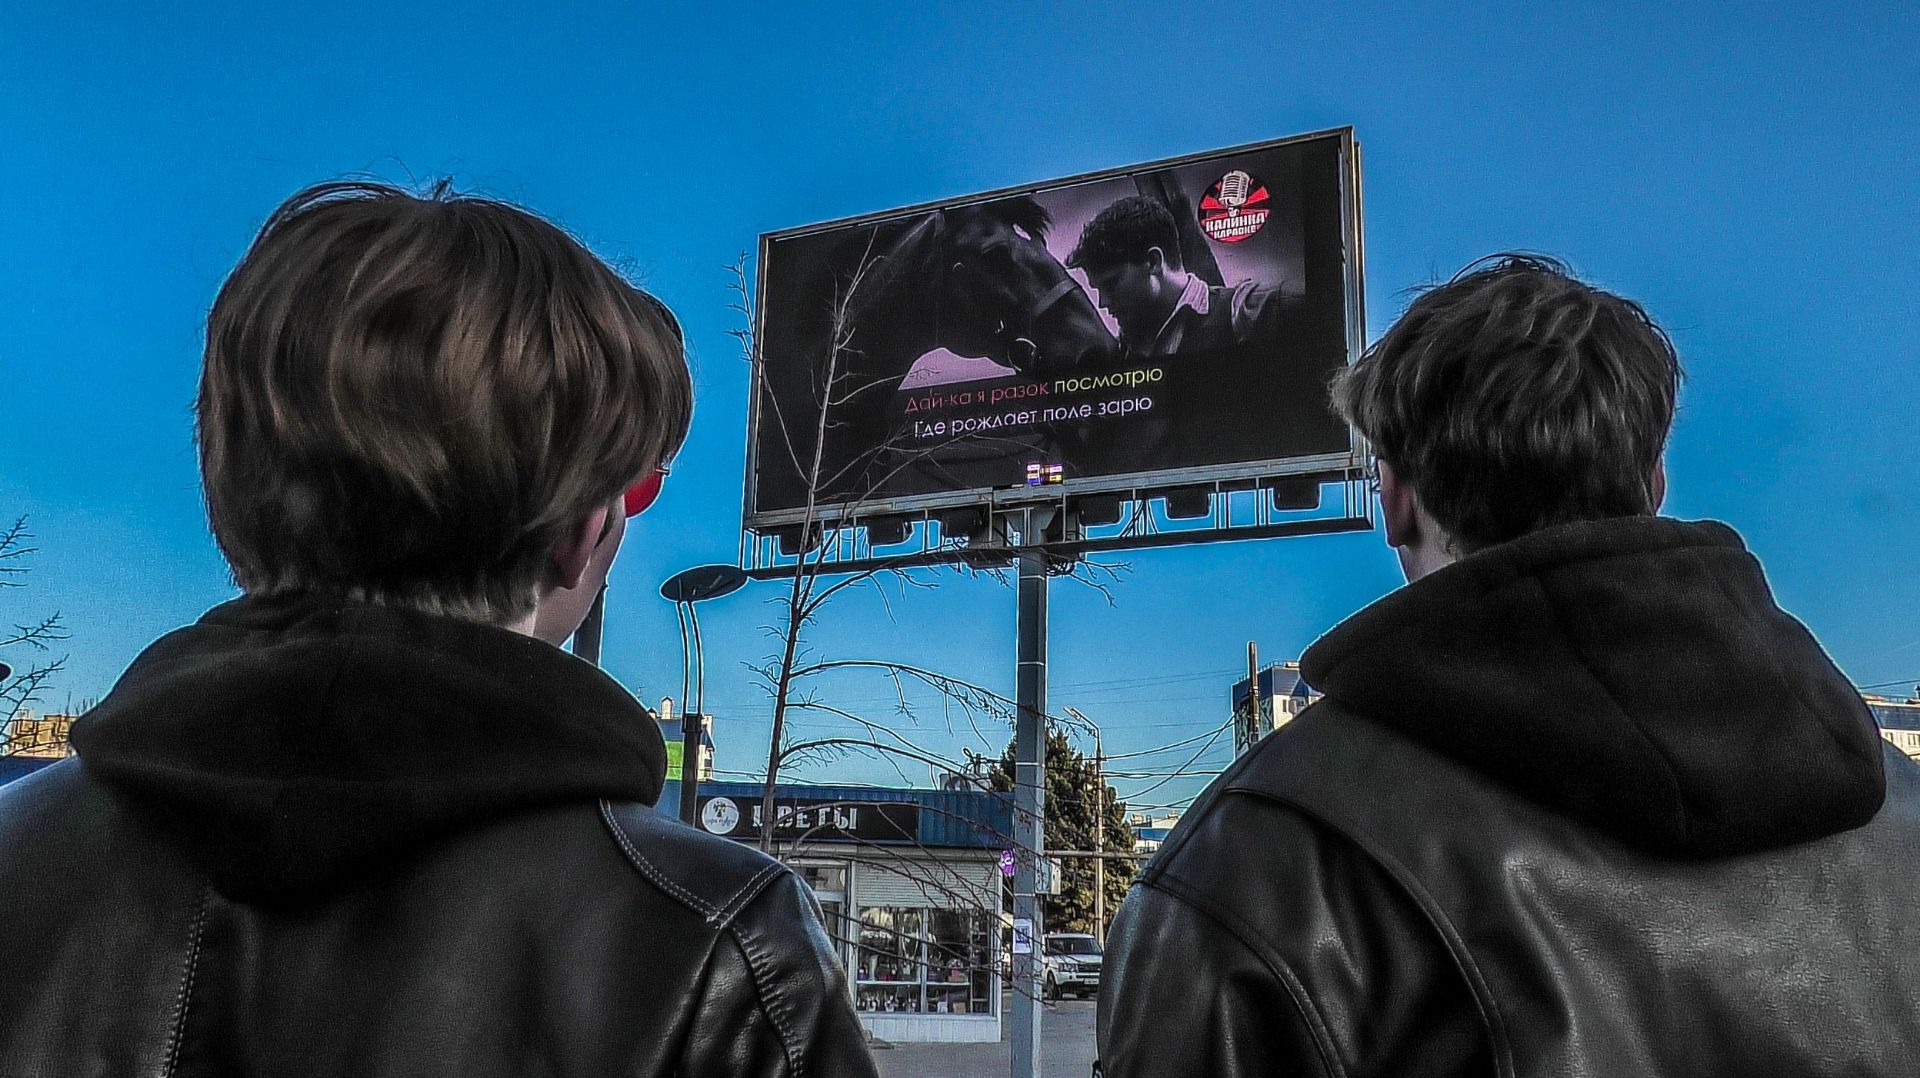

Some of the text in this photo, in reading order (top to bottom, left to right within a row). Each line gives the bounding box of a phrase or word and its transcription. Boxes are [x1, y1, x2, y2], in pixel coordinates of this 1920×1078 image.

[1205, 212, 1266, 232] КАЛИНКА
[1213, 225, 1257, 239] КАРАОКЕ
[904, 368, 1164, 413] Дай-ка я разок посмотрю
[914, 421, 946, 438] Где
[1043, 404, 1092, 422] поле
[1098, 397, 1153, 417] зарю
